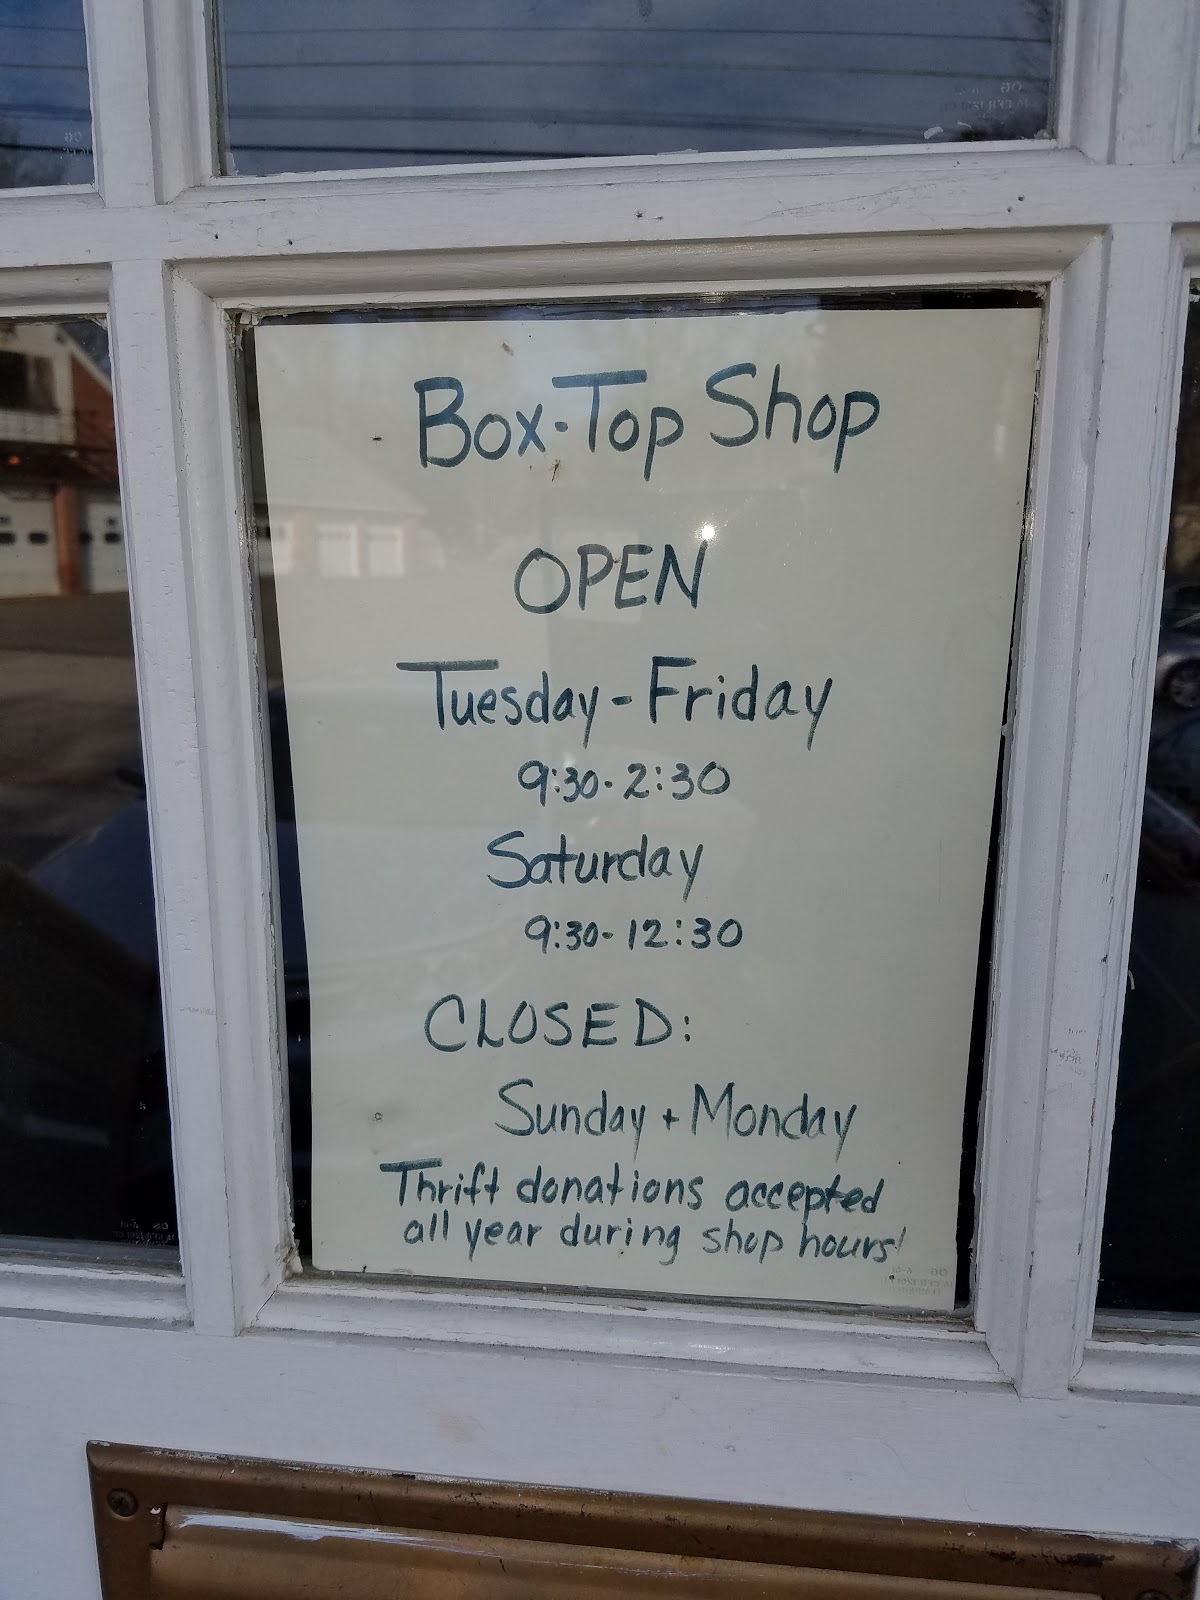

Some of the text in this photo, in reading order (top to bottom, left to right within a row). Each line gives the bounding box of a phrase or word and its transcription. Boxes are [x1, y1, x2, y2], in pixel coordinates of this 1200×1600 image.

[705, 362, 881, 474] Shop
[513, 541, 708, 615] OPEN
[486, 829, 704, 904] Saturday
[423, 993, 692, 1053] CLOSED:
[494, 1077, 647, 1160] Sunday
[691, 1081, 858, 1163] Monday
[378, 1157, 885, 1222] Thrift donations accepted
[403, 1208, 450, 1245] all
[464, 1217, 543, 1263] year
[559, 1211, 681, 1267] during
[701, 1217, 785, 1265] shop
